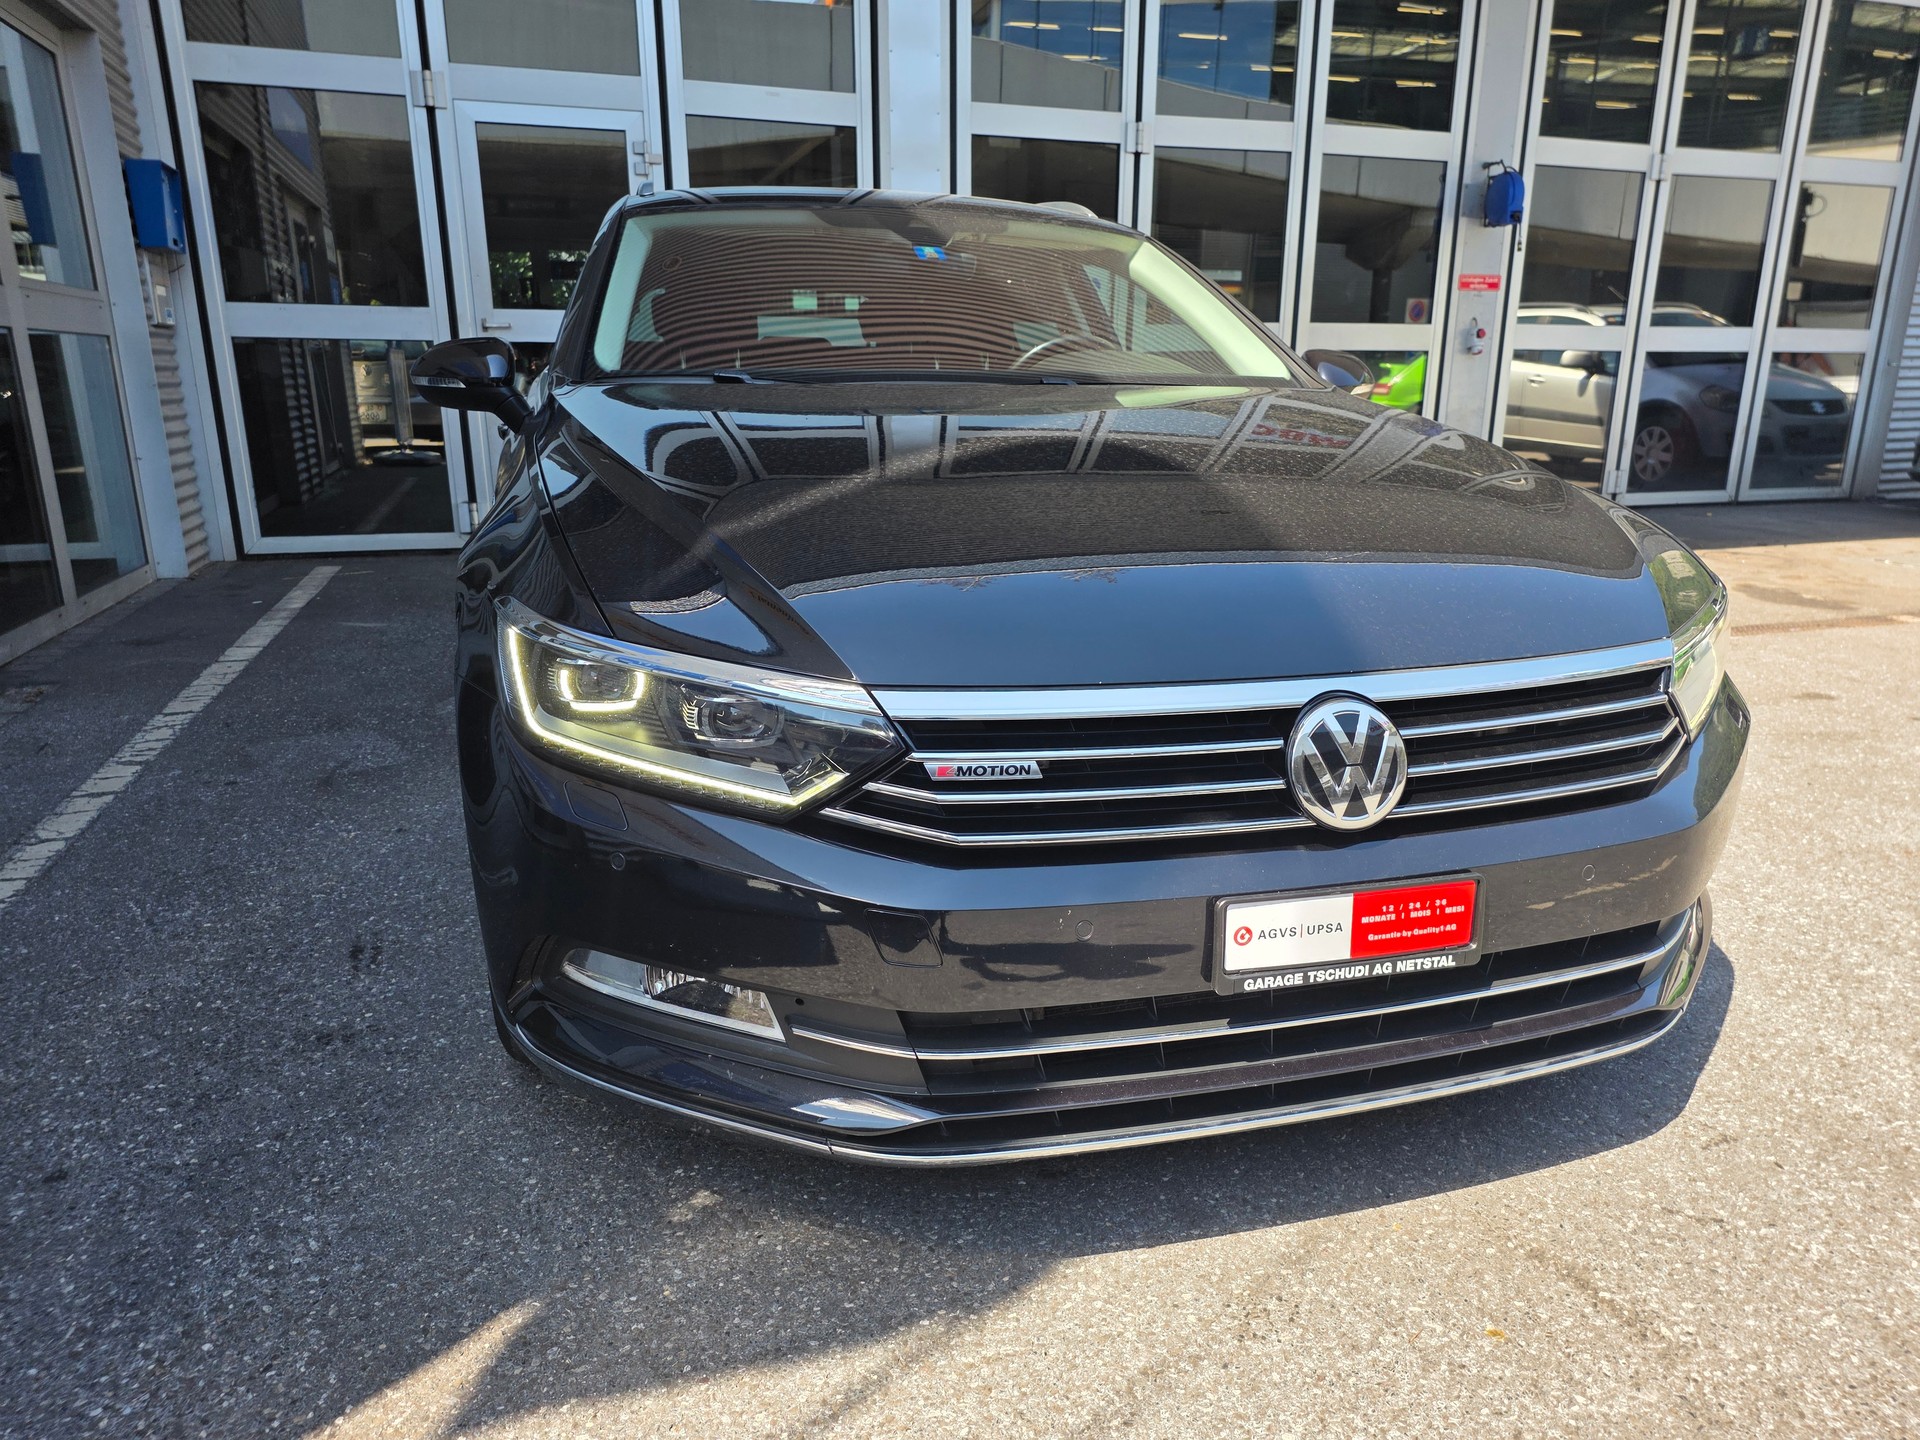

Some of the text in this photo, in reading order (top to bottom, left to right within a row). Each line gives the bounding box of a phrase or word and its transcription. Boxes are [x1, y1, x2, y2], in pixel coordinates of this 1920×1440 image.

[1361, 913, 1396, 924] MONATE
[1410, 909, 1431, 918] MOIS
[1445, 905, 1465, 914] MESI
[1409, 902, 1421, 910] 24
[1258, 926, 1297, 940] AGVS
[1307, 922, 1343, 936] UPSA
[1368, 931, 1400, 941] Garantie
[1402, 929, 1412, 938] by
[1445, 923, 1457, 932] AG
[1243, 955, 1456, 991] GARAGE TSCHUDI AG NETSTAL
